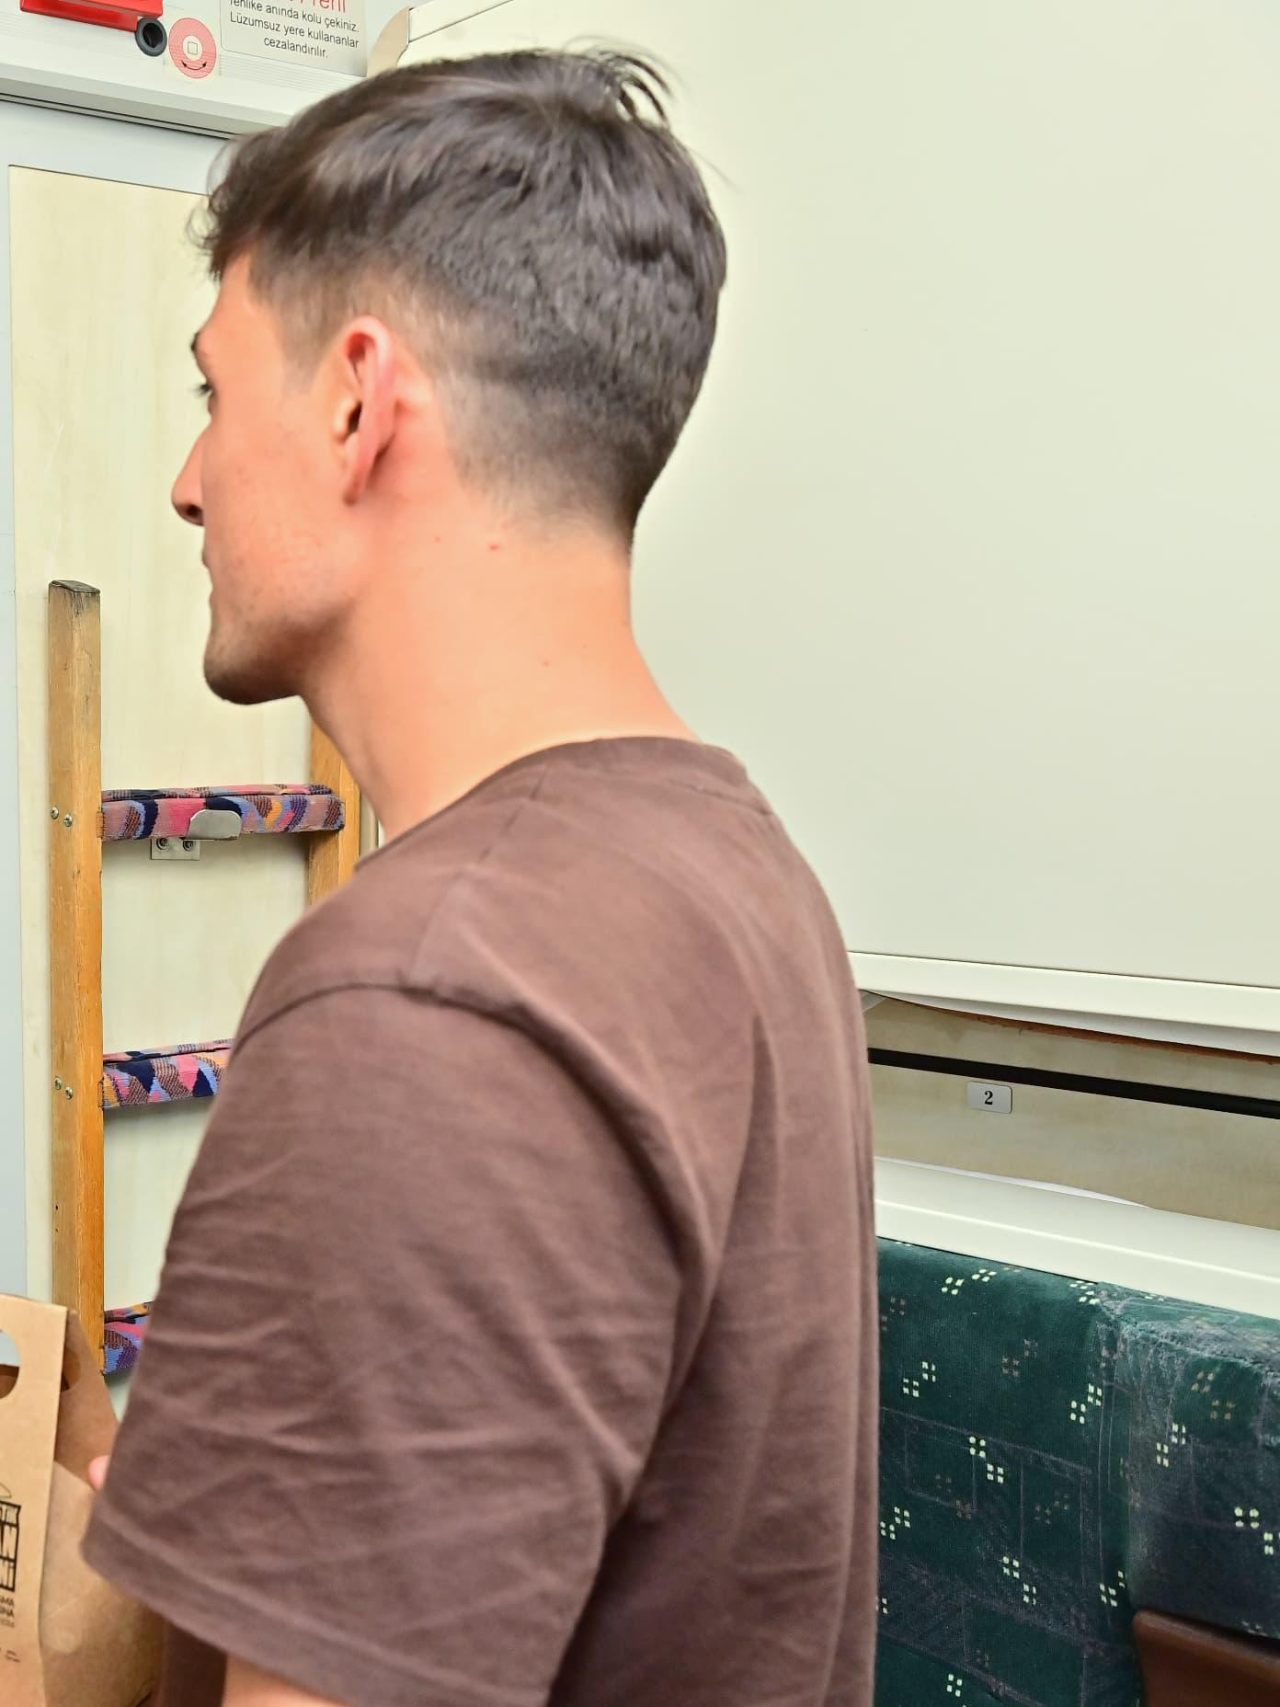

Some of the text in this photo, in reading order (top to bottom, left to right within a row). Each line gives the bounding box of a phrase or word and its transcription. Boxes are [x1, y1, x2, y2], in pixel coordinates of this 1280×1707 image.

[265, 5, 299, 19] anında
[302, 11, 321, 24] kolu
[230, 11, 360, 48] Lüzumsuz yere kullananlar
[984, 1090, 993, 1106] 2
